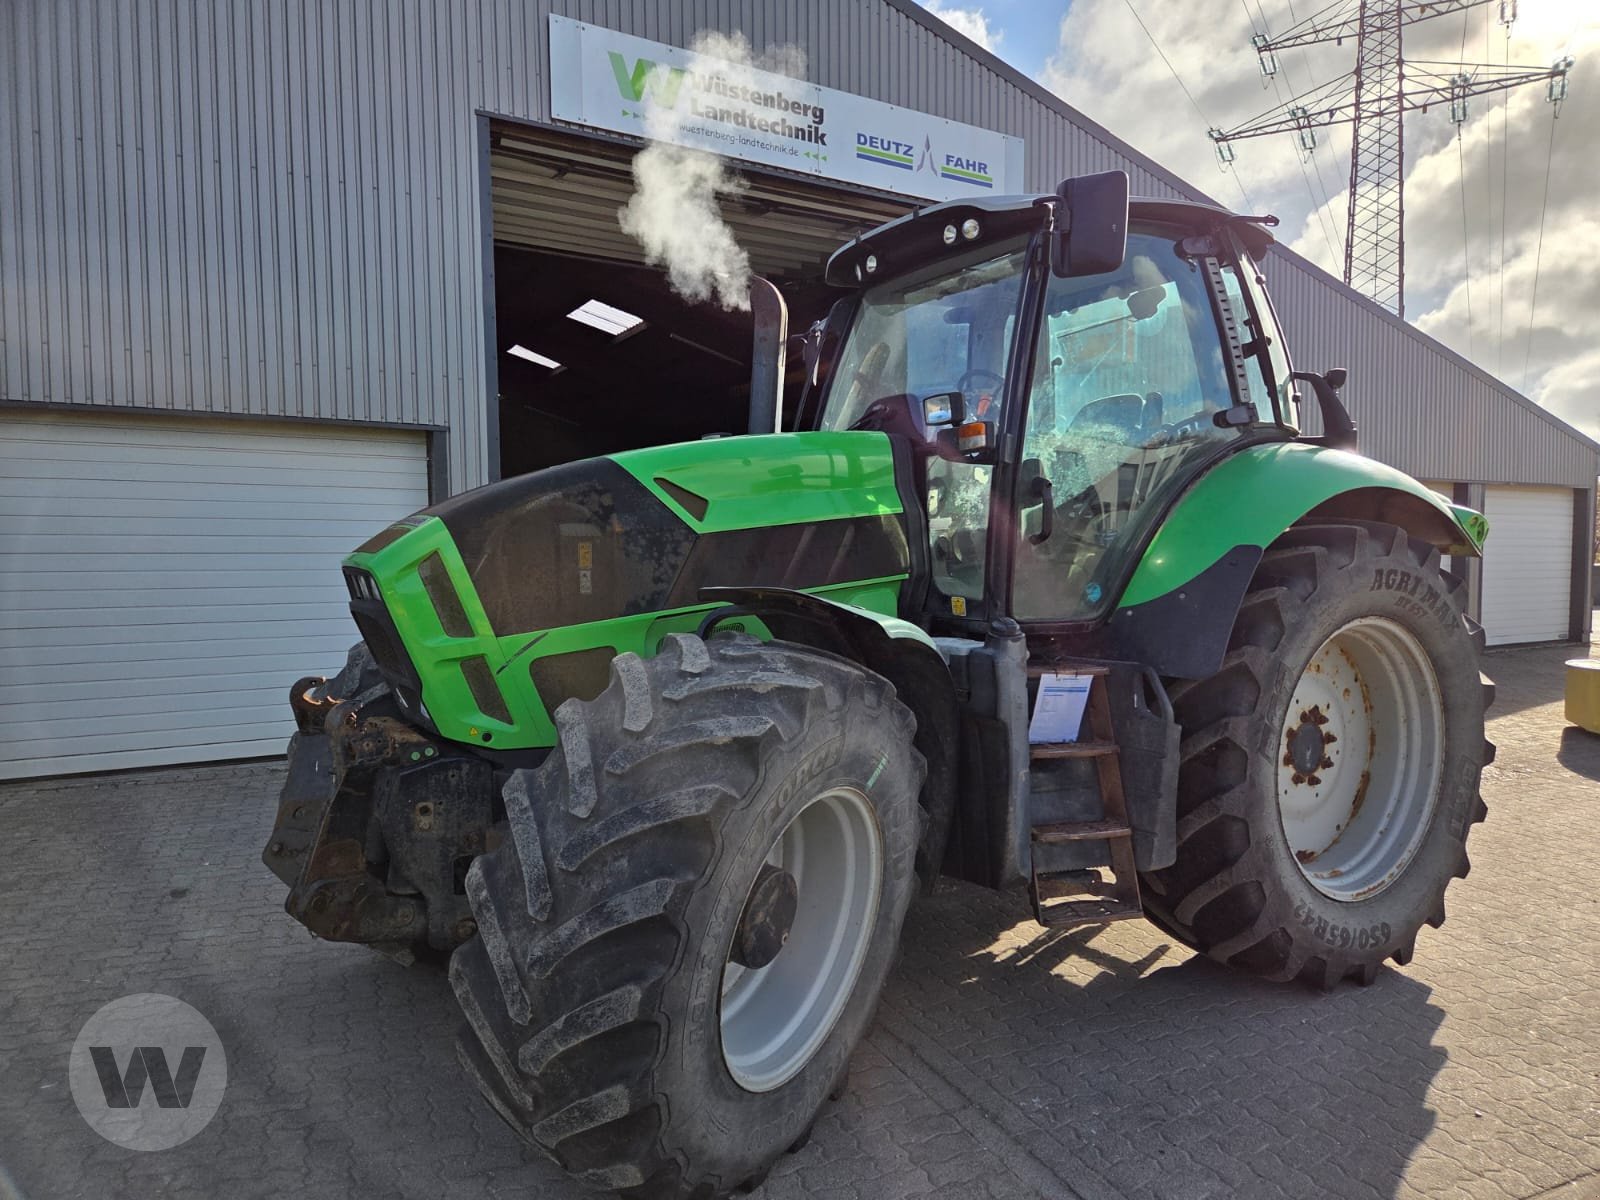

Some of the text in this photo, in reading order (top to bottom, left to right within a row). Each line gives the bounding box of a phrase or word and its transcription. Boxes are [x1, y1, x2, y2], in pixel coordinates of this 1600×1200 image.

[656, 119, 800, 157] wuestenberg-landtechnik.de
[690, 97, 828, 146] Landtechnik
[856, 132, 988, 175] DEUTZ FAHR
